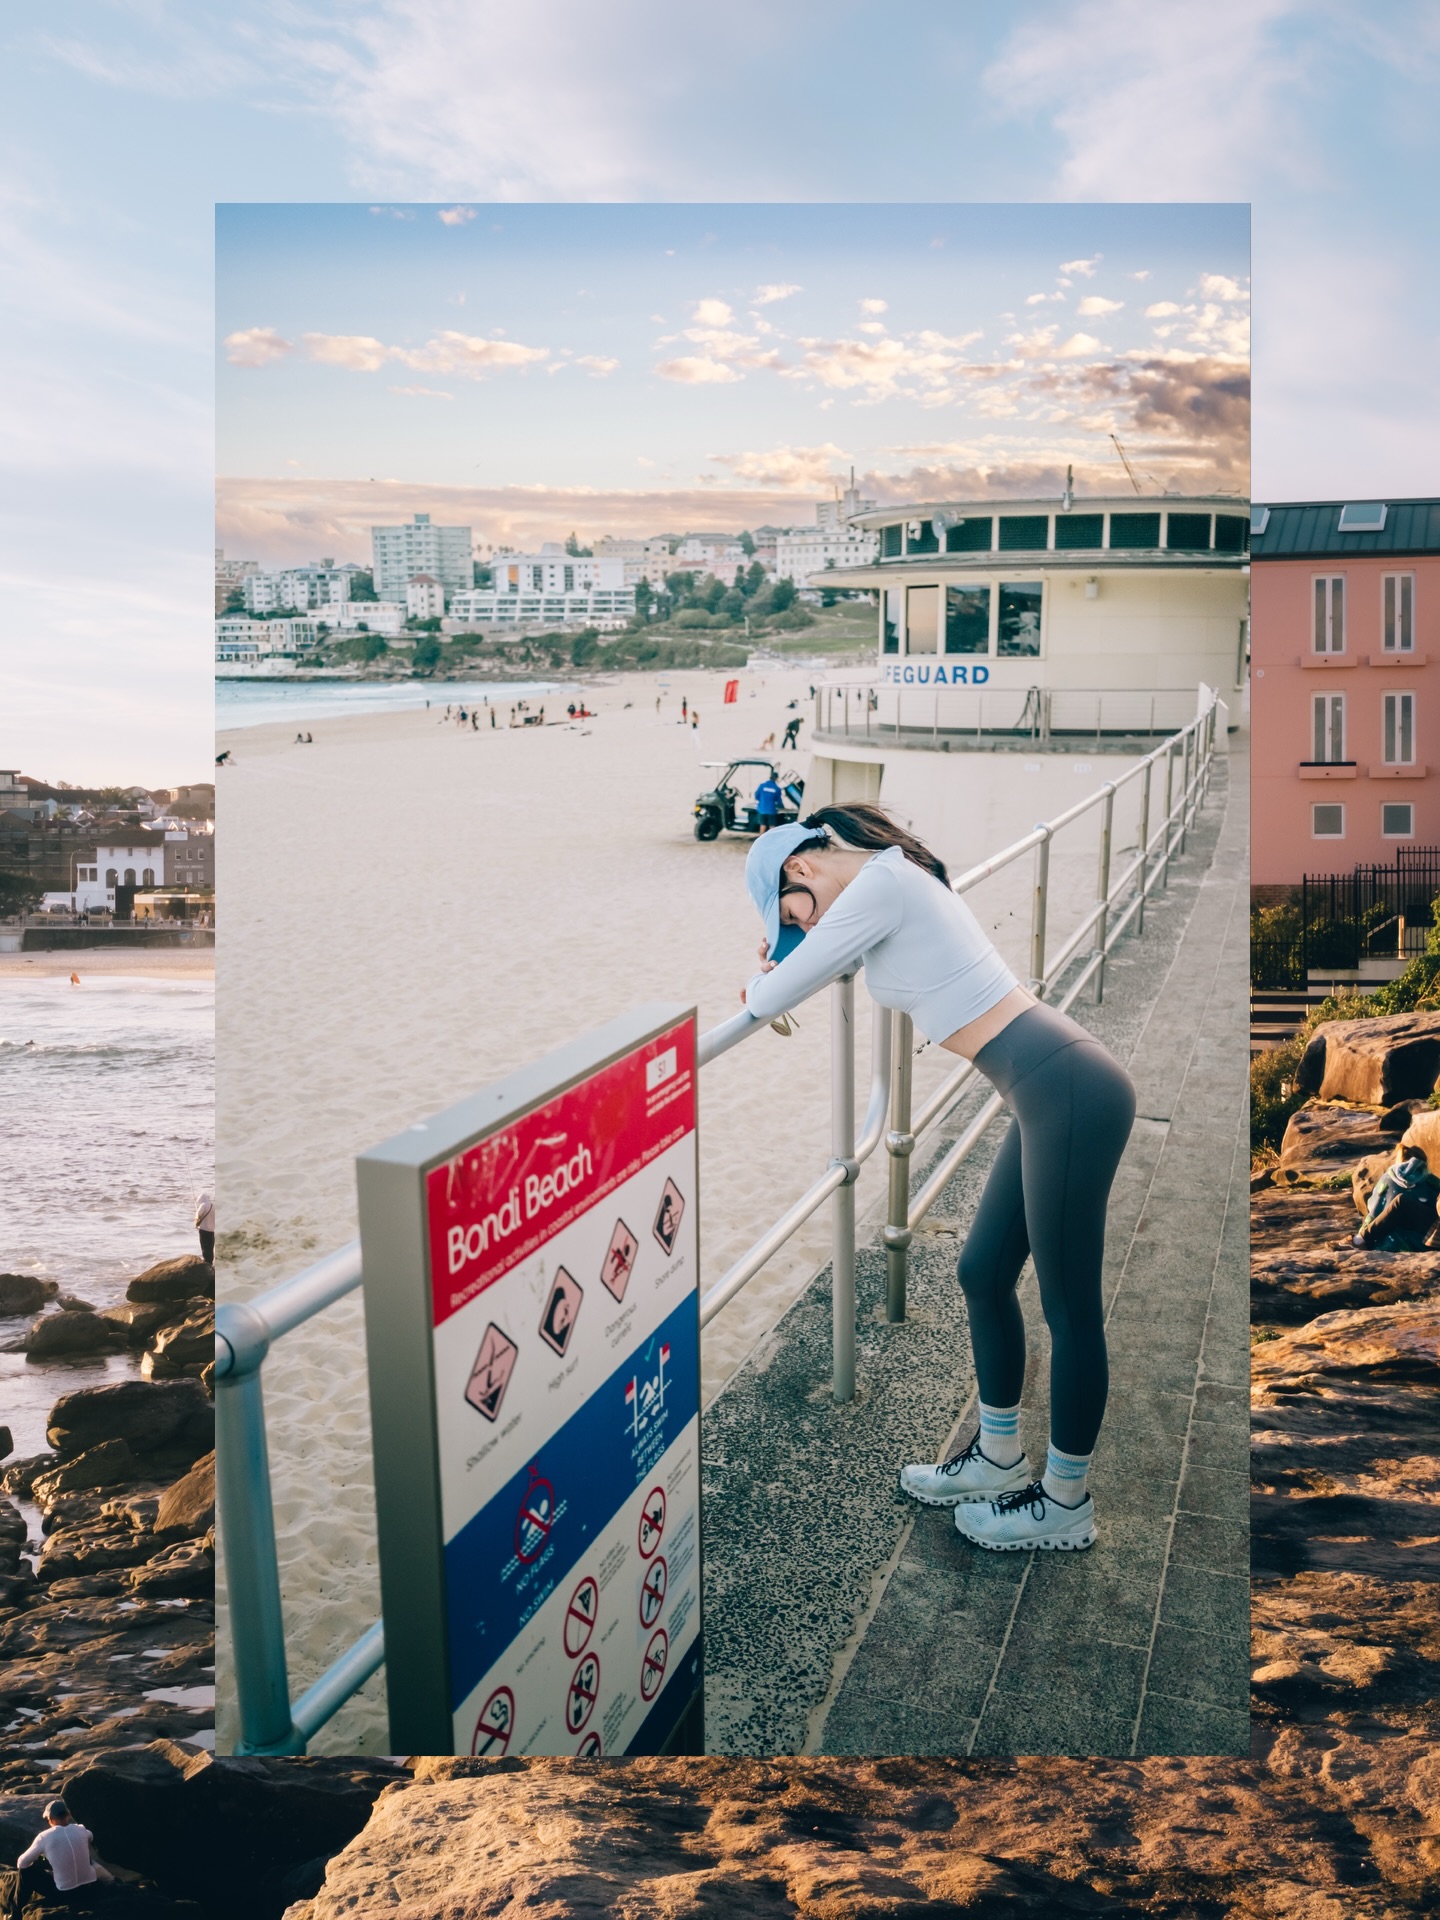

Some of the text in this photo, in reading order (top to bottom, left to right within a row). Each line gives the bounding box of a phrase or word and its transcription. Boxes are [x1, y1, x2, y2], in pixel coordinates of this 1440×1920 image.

[447, 1142, 593, 1275] Bondi Beach
[630, 1408, 669, 1460] ALWAYS SWIM
[637, 1429, 663, 1468] BETWEEN
[635, 1442, 665, 1484] THE FLAGS
[516, 1542, 555, 1595] NO FLAGS
[518, 1579, 554, 1628] NO SWIM
